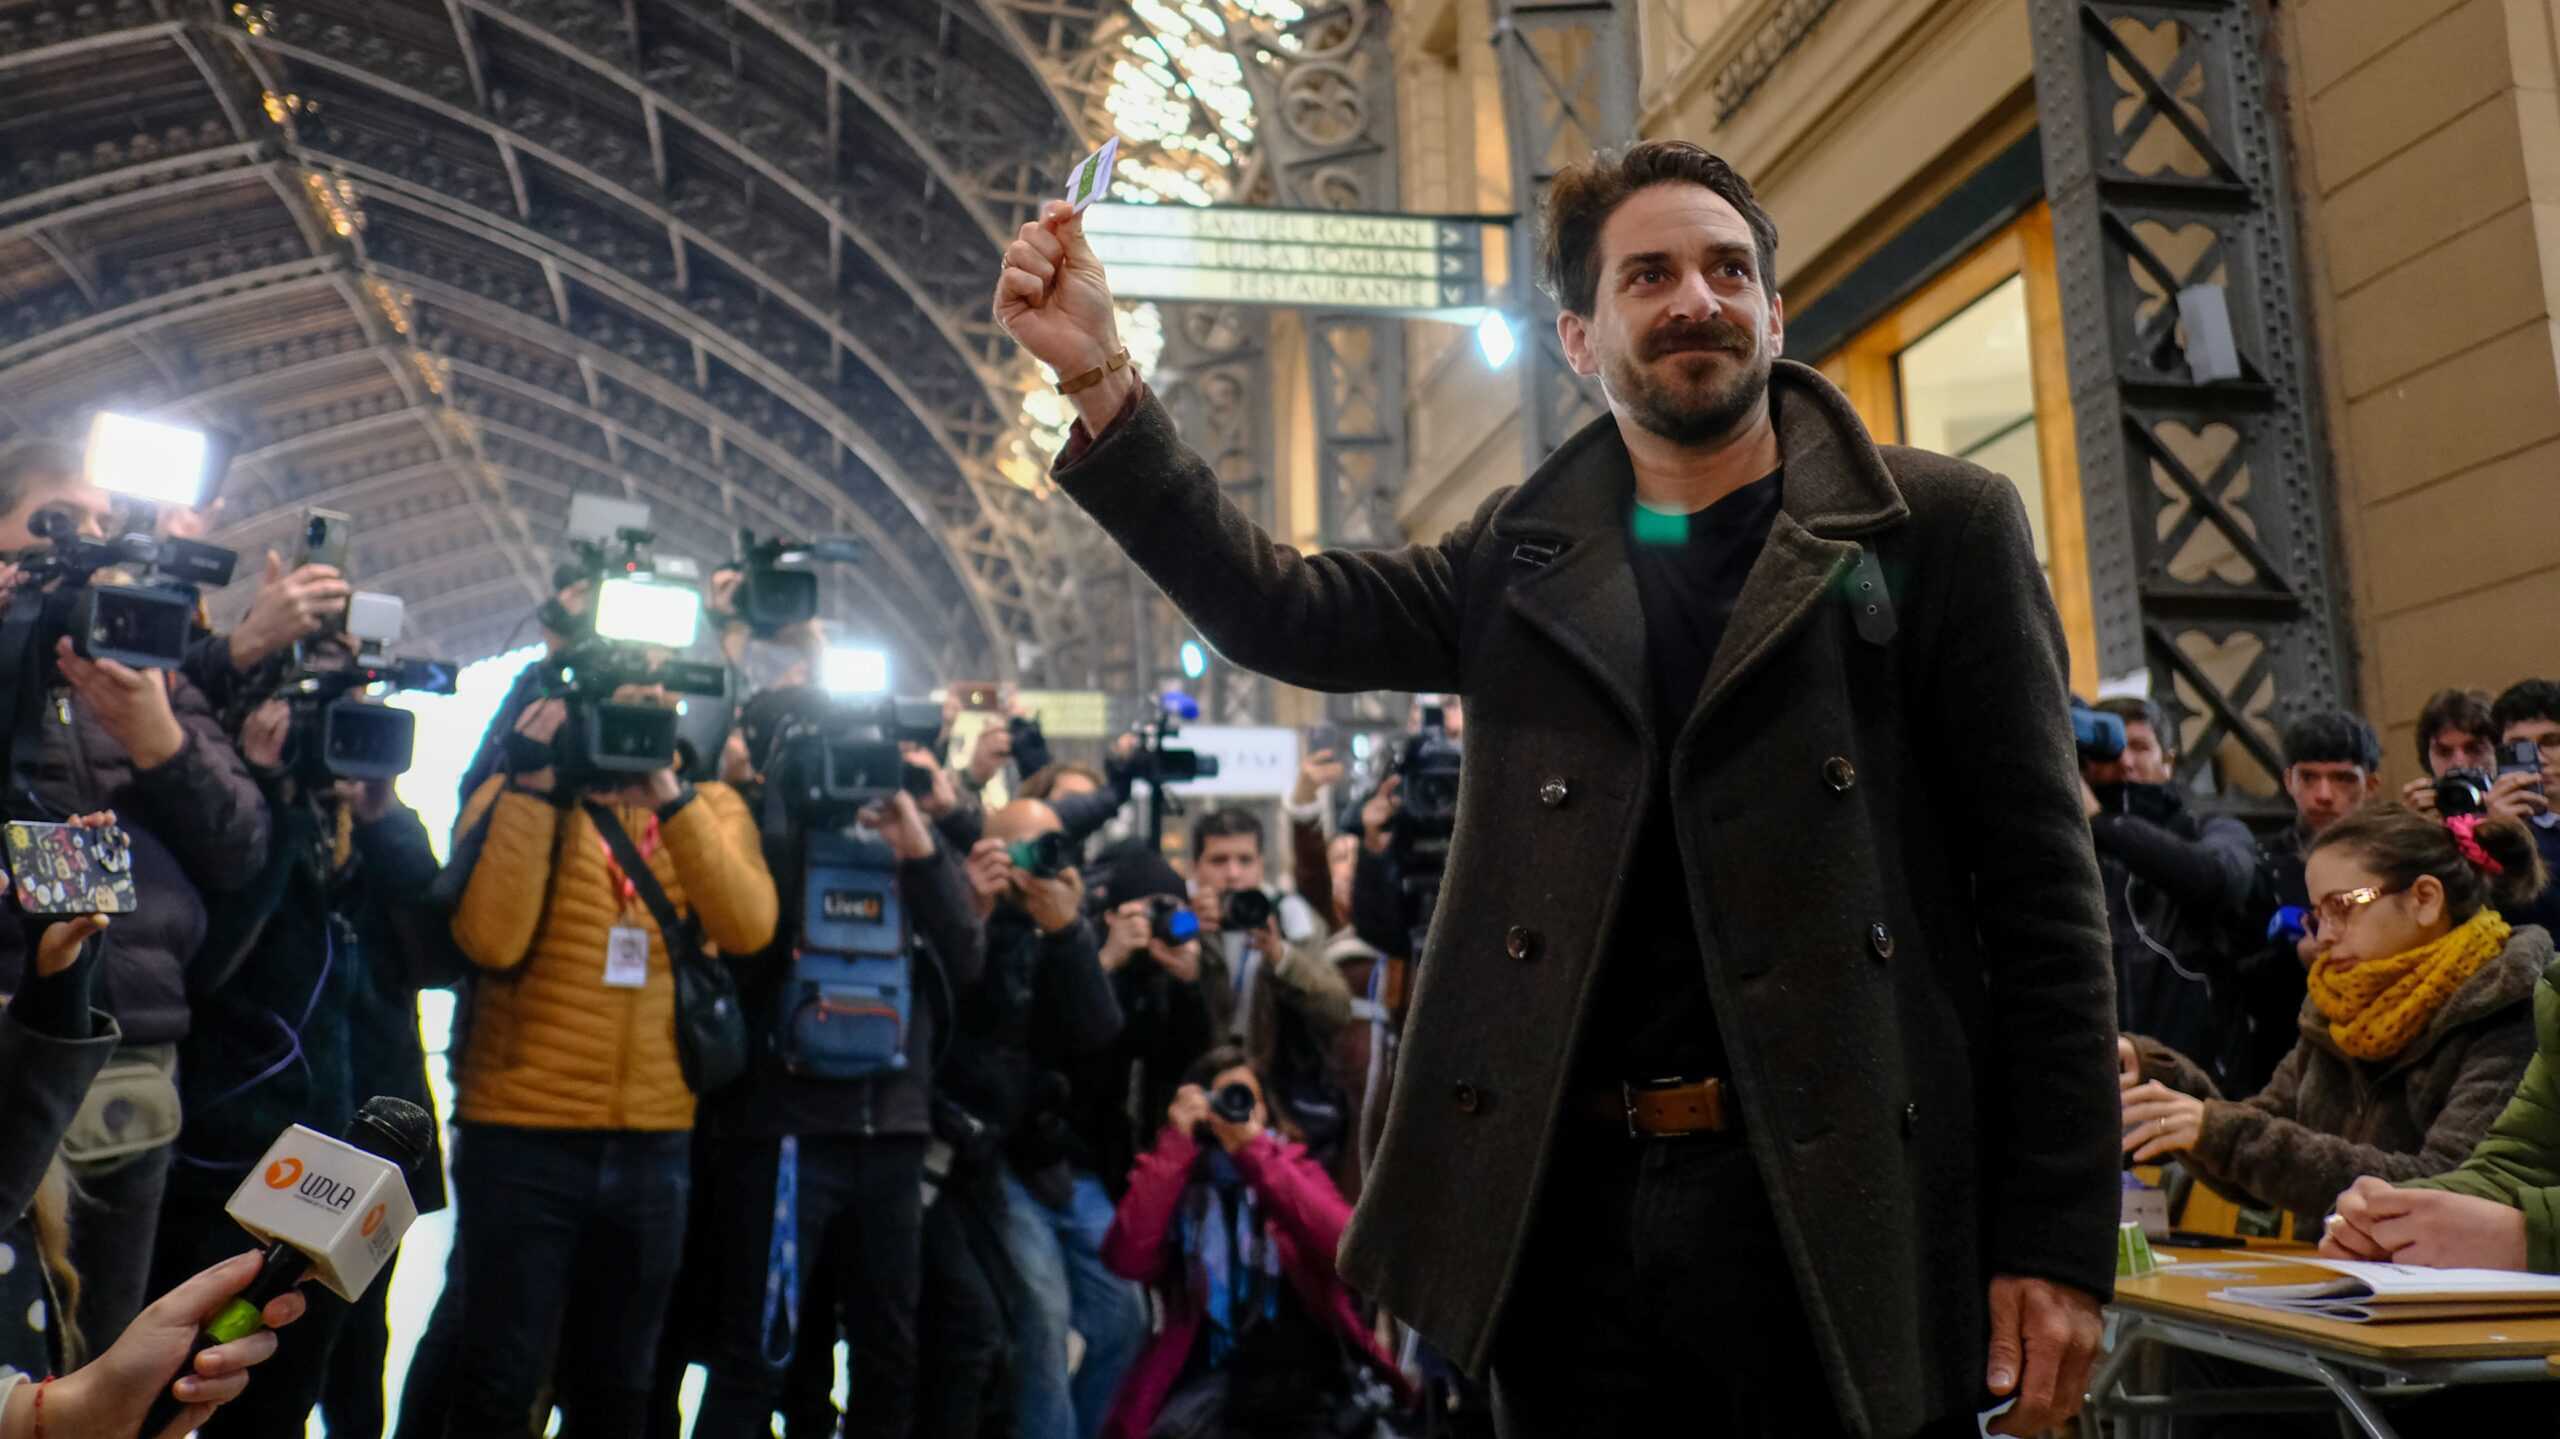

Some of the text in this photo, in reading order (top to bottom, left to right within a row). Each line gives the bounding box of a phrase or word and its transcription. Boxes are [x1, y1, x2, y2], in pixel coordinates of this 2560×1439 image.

[1215, 242, 1293, 270] LUISA
[1231, 275, 1423, 305] RESTAURANTE
[300, 1172, 356, 1210] UDLA
